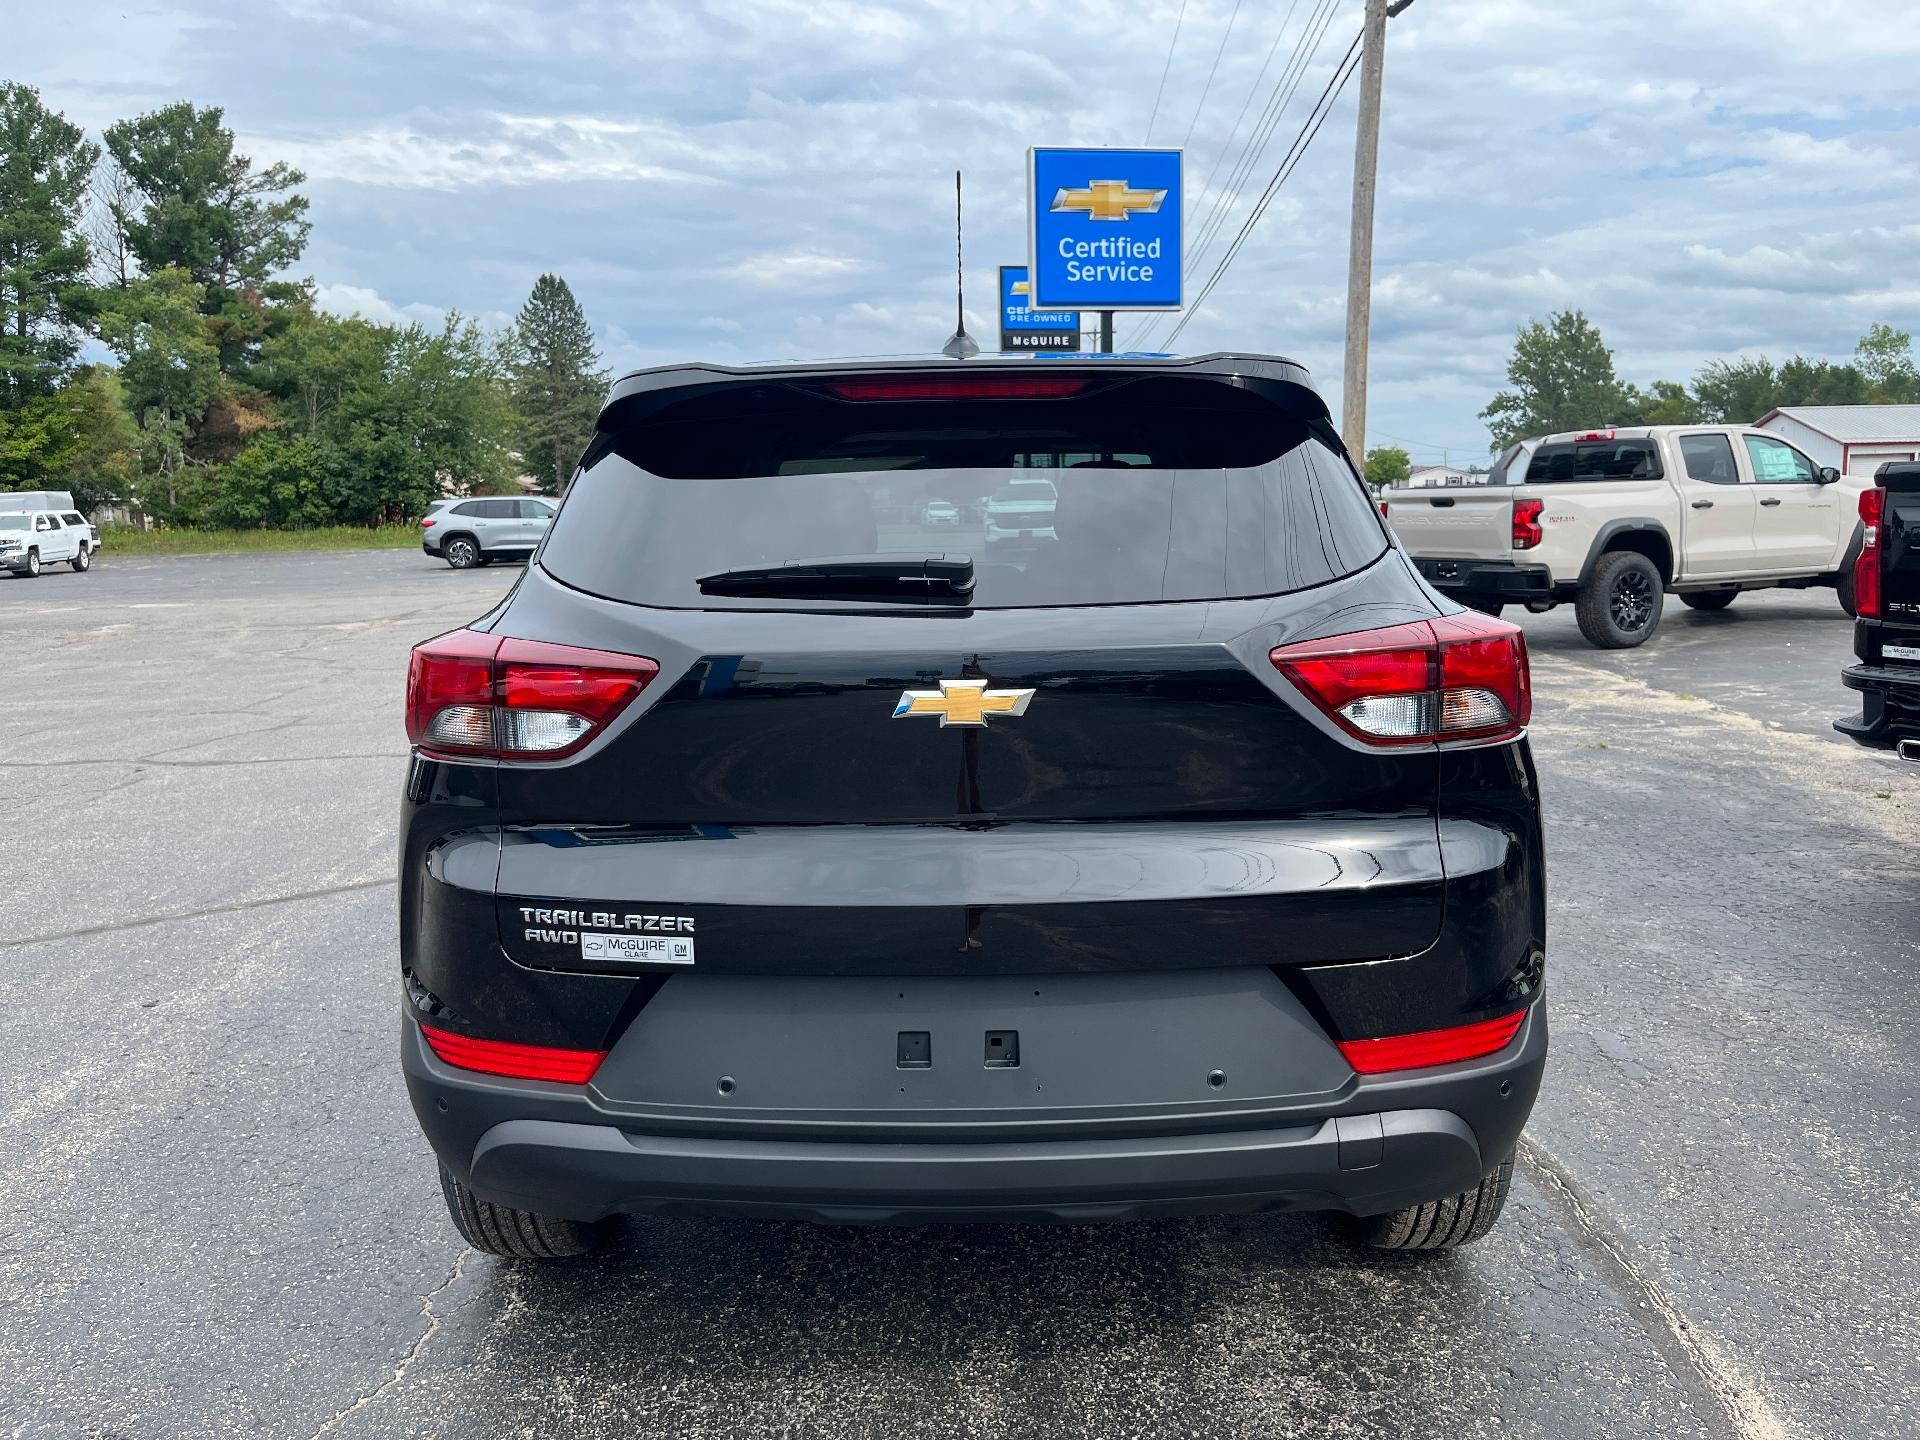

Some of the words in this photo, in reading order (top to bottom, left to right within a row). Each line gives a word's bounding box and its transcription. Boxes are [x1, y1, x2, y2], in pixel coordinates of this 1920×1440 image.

[1059, 237, 1161, 259] Certified
[1066, 261, 1153, 282] Service
[1010, 315, 1071, 323] PRE-OWNED
[1012, 336, 1069, 346] McGUIRE
[519, 907, 695, 933] TRAILBLAZER
[525, 928, 579, 945] AWD
[608, 938, 666, 952] McGUIRE
[674, 944, 687, 954] GM
[624, 950, 649, 959] CLARE
